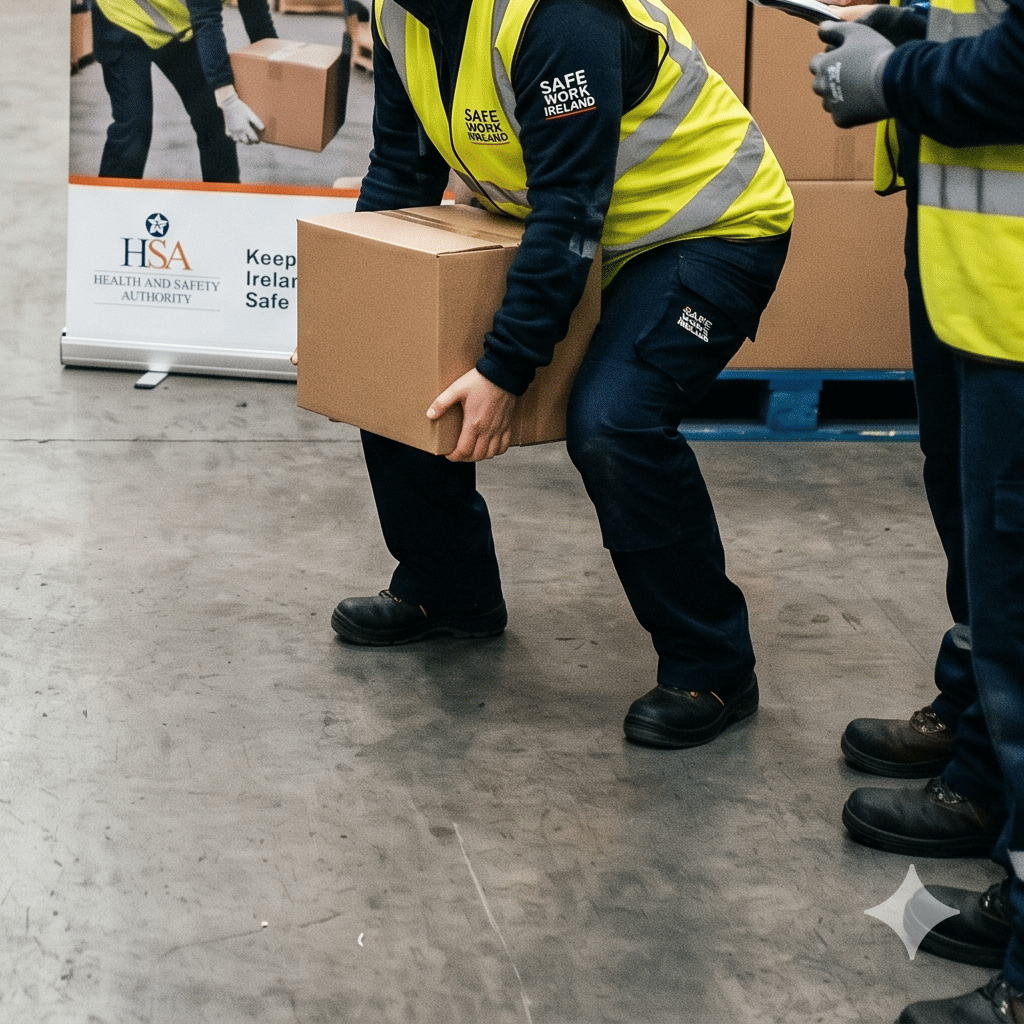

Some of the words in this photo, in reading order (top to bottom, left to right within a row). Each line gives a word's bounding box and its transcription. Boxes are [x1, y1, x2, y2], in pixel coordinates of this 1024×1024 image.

[539, 69, 588, 95] SAFE
[543, 84, 591, 106] WORK
[464, 108, 500, 123] SAFE
[543, 96, 596, 117] IRELAND
[465, 122, 503, 133] WORK
[120, 237, 193, 271] HSA
[246, 248, 297, 270] Keep
[93, 274, 141, 287] HEALTH
[144, 278, 172, 289] AND
[173, 279, 221, 292] SAFETY
[121, 291, 192, 304] AUTHORITY
[245, 291, 290, 310] Safe
